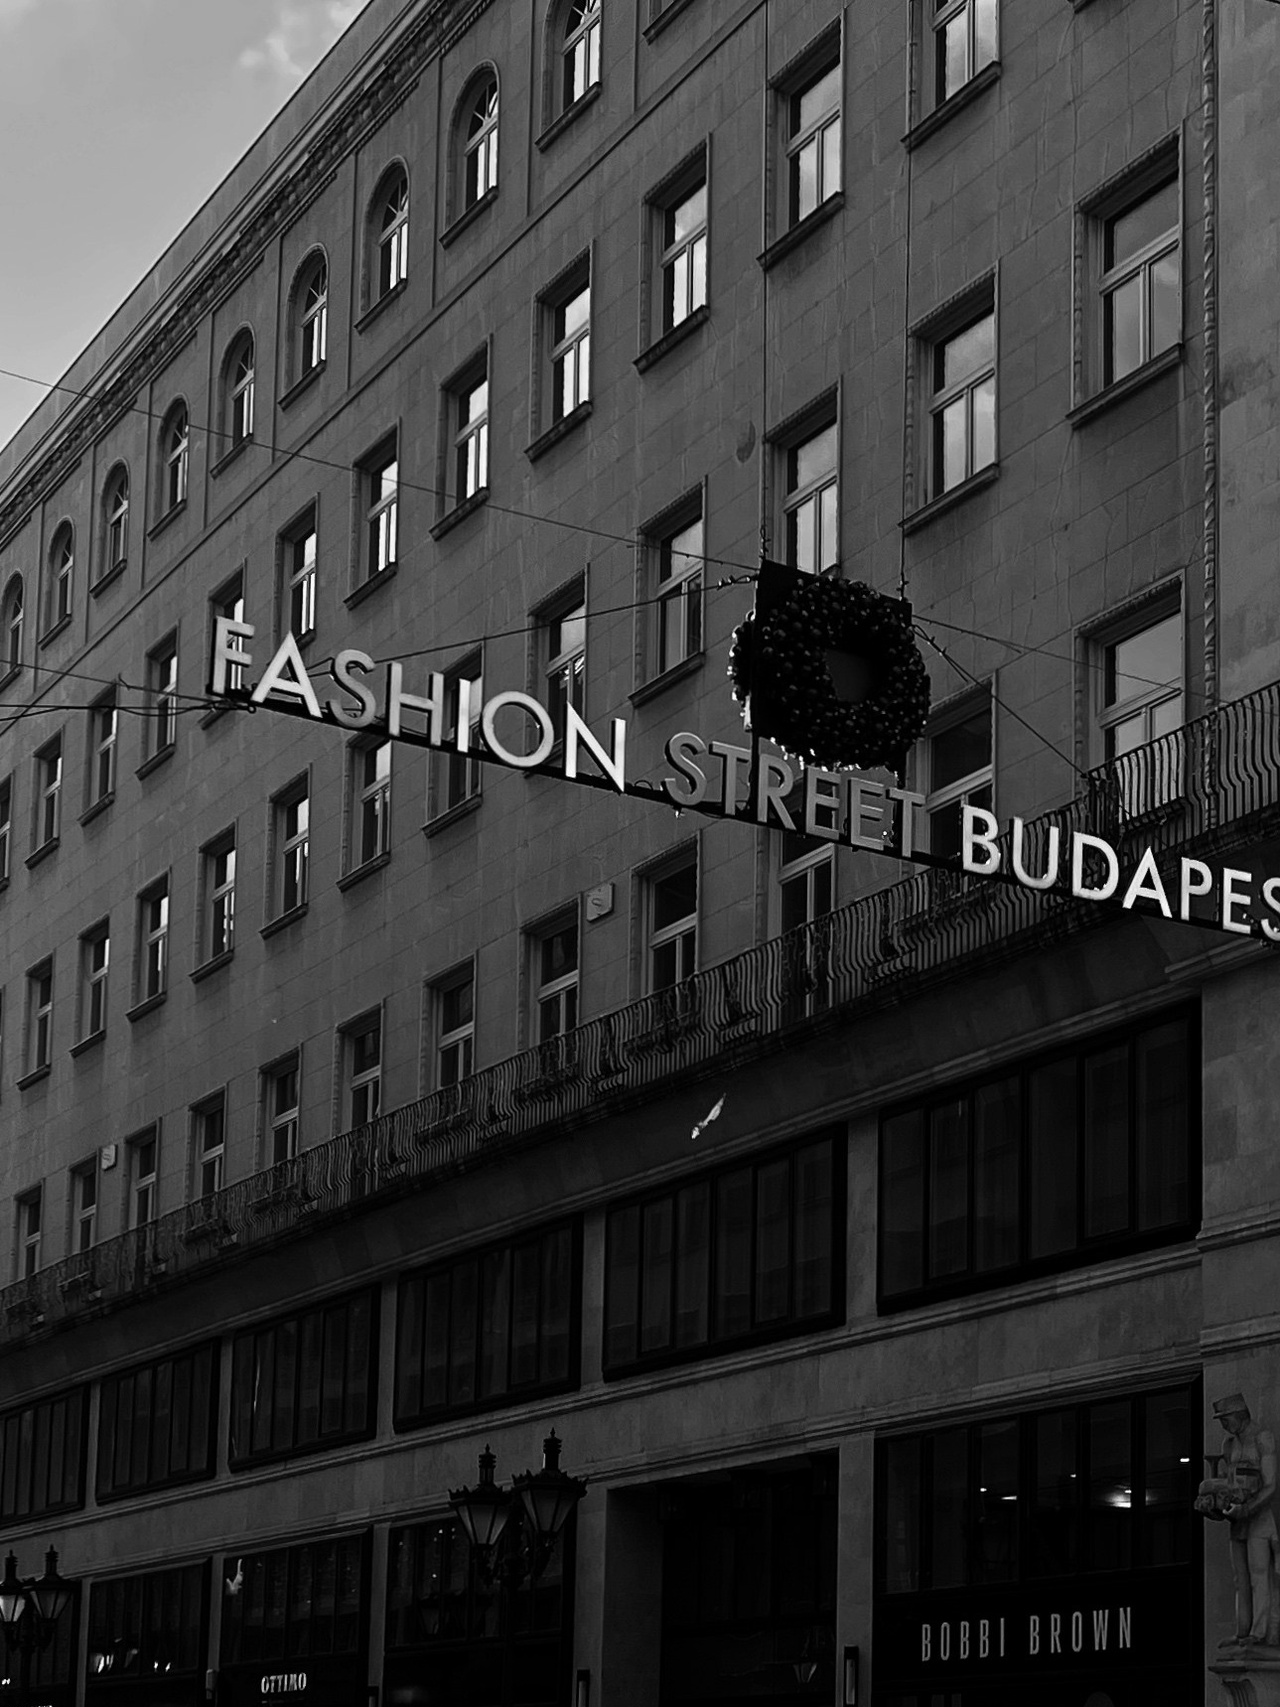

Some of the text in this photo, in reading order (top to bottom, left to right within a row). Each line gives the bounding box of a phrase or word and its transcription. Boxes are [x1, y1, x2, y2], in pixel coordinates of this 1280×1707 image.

[211, 616, 627, 792] FASHION
[663, 731, 926, 860] STREET
[921, 1606, 1132, 1662] BOBBI BROWN
[261, 1672, 307, 1694] OTTIMO
